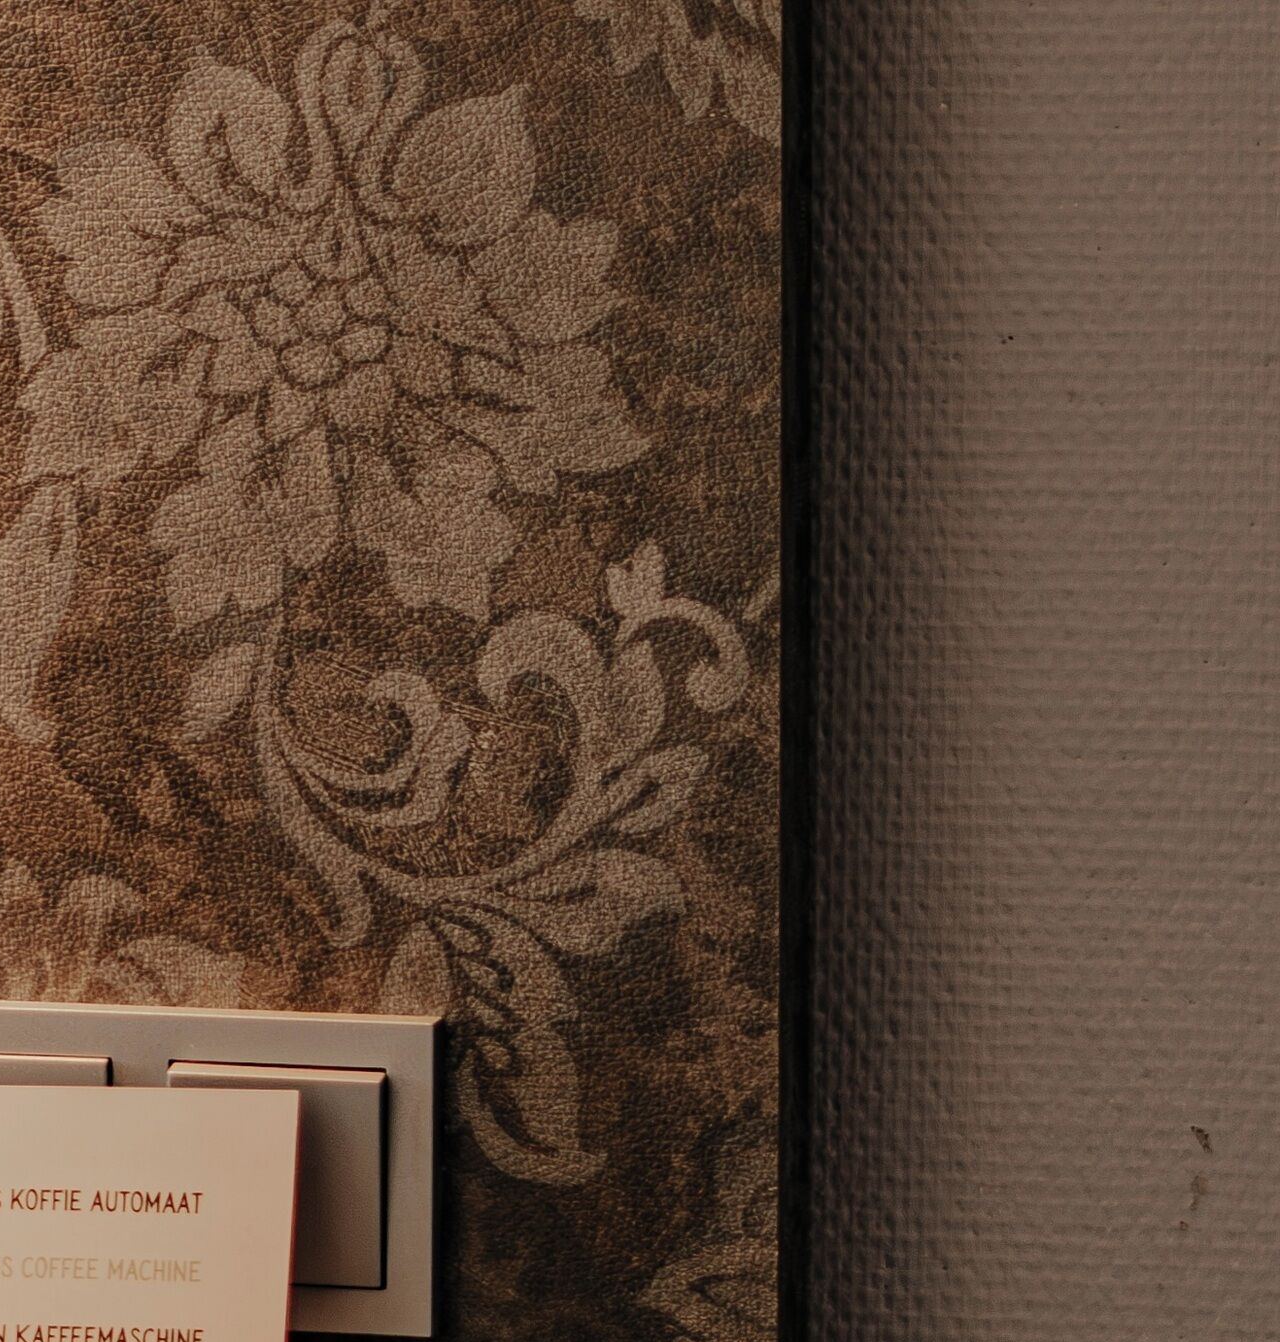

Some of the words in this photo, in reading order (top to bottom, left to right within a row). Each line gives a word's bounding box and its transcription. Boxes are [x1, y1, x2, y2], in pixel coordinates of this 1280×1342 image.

[10, 1188, 81, 1211] KOFFIE
[90, 1190, 203, 1214] AUTOMAAT
[21, 1256, 99, 1280] COFFEE
[107, 1258, 201, 1282] MACHINE
